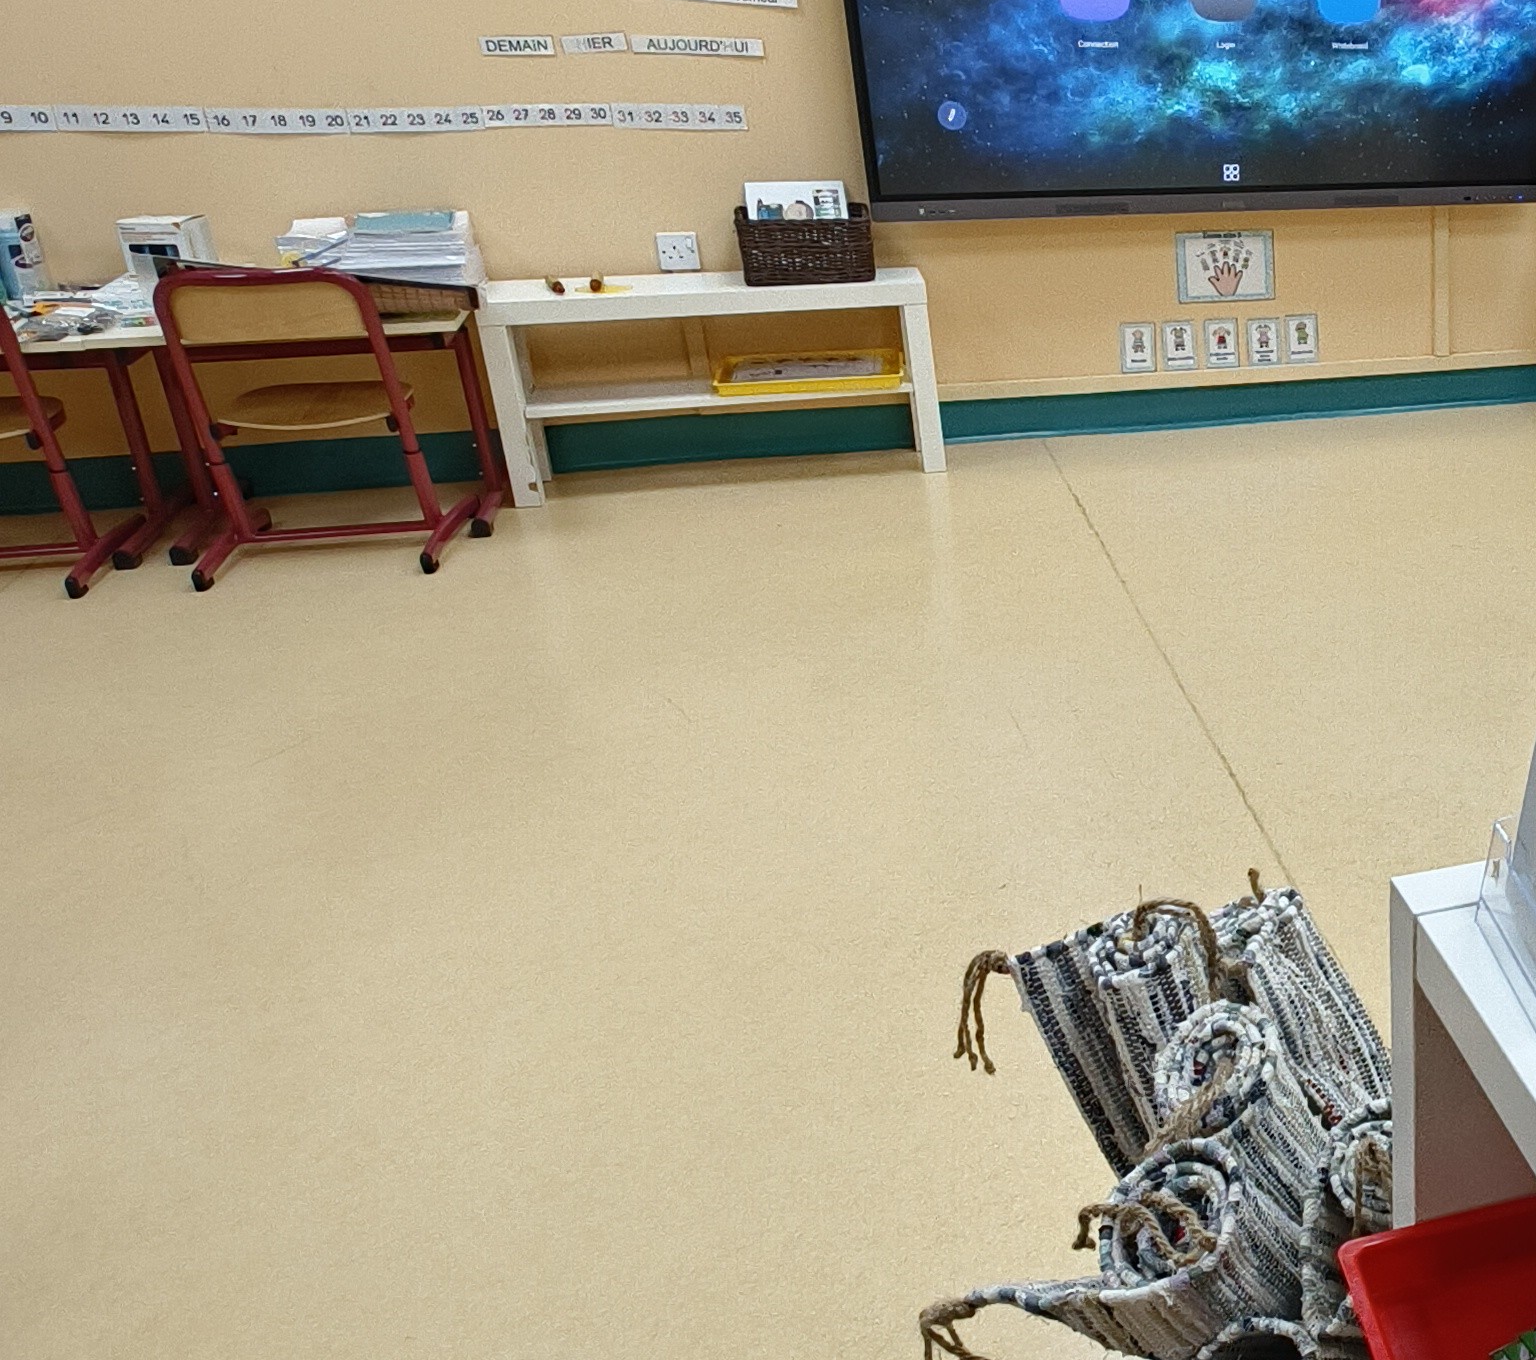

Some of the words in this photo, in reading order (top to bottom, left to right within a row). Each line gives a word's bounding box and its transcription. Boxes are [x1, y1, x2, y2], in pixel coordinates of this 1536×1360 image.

[647, 38, 748, 53] AUJOURD'HUI
[1, 112, 12, 124] 9
[30, 112, 48, 124] 10
[63, 112, 79, 124] 11
[94, 112, 110, 124] 12
[122, 113, 140, 124] 13
[152, 113, 169, 124] 14
[184, 113, 200, 125] 15
[213, 114, 230, 126] 16
[242, 114, 257, 126] 17
[271, 114, 286, 126] 18
[300, 114, 315, 126] 19
[326, 114, 344, 127] 20
[355, 114, 370, 126] 21
[381, 114, 397, 125] 22
[407, 113, 425, 125] 23
[435, 113, 452, 124] 24
[462, 113, 478, 124] 25
[487, 109, 504, 121] 26
[513, 108, 528, 120] 27
[539, 108, 555, 120] 28
[565, 108, 581, 120] 29
[591, 108, 606, 120] 30
[617, 110, 633, 123] 31
[644, 110, 662, 123] 32
[670, 110, 688, 123] 33
[699, 110, 715, 123] 34
[726, 111, 742, 124] 35
